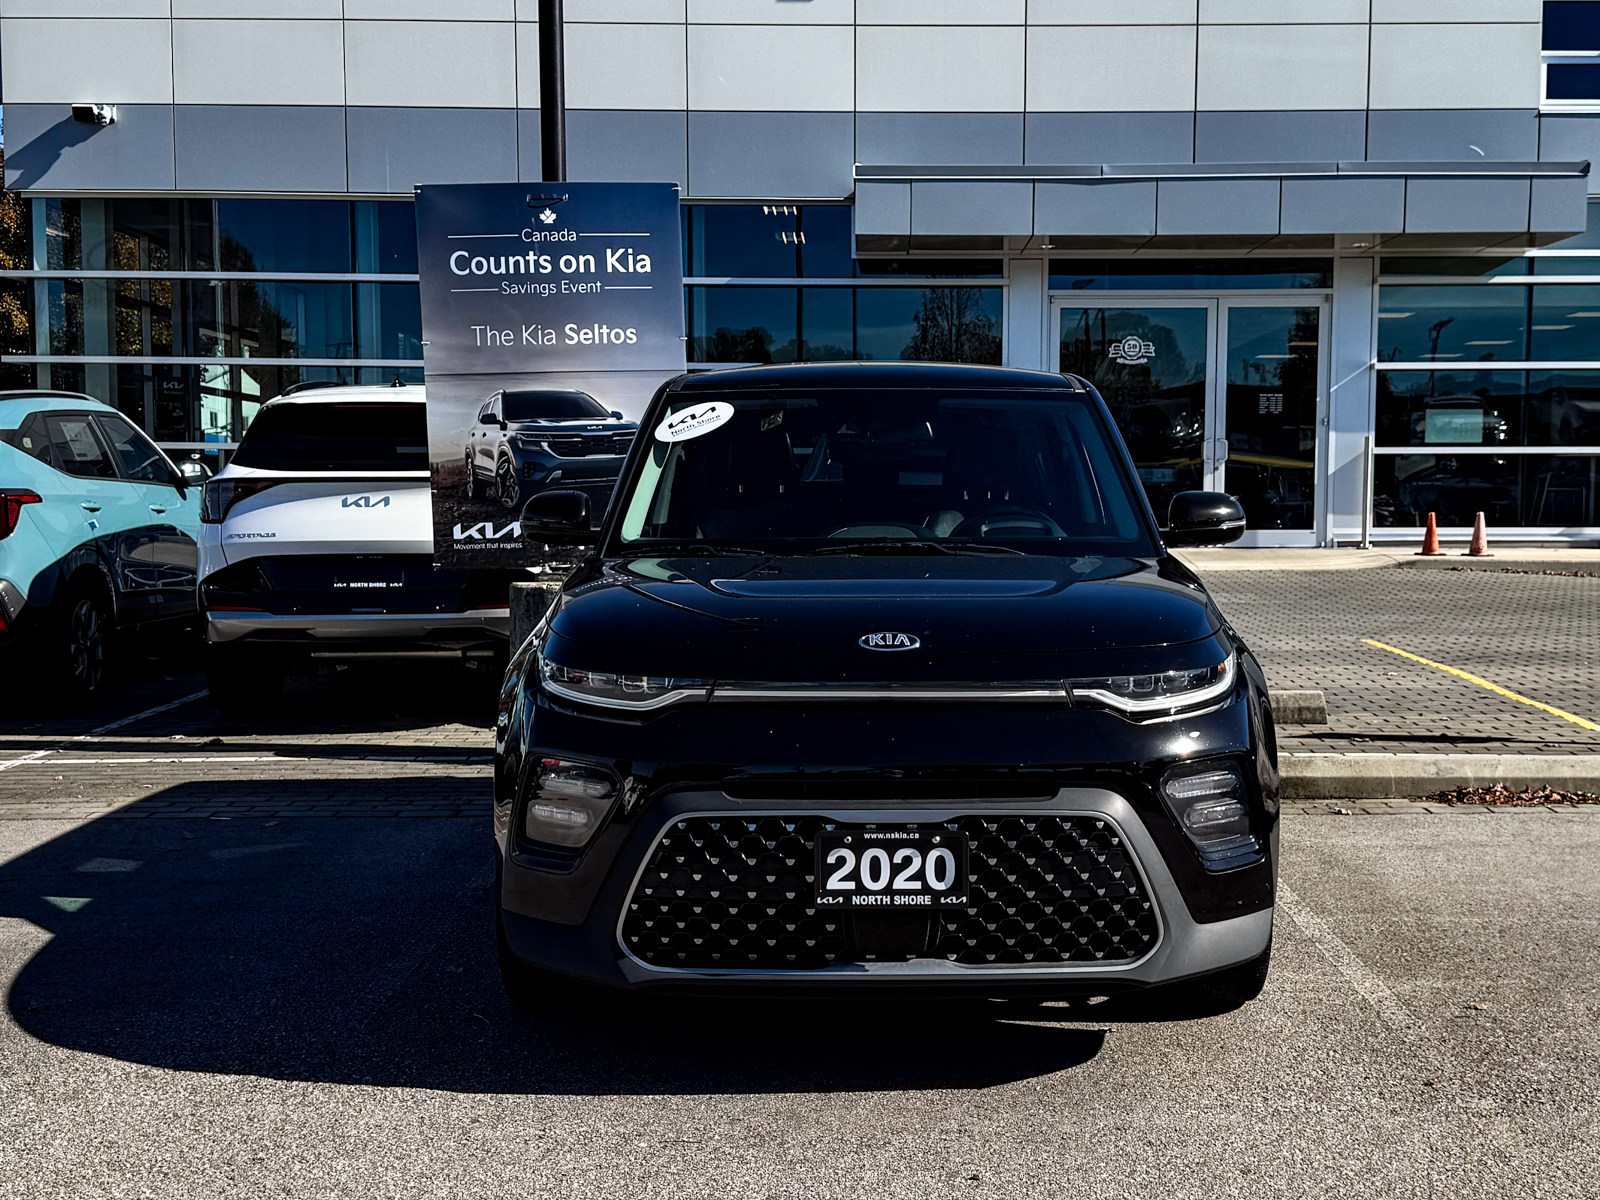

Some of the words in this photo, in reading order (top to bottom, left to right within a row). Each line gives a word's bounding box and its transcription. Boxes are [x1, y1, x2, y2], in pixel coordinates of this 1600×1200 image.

[521, 228, 577, 242] Canada
[449, 250, 552, 276] Counts
[559, 254, 595, 273] on
[605, 248, 652, 273] Kia
[501, 280, 557, 297] Savings
[562, 280, 602, 293] Event
[471, 325, 514, 346] The
[522, 324, 556, 345] Kia
[564, 323, 637, 344] Seltos
[671, 423, 695, 436] North
[342, 496, 390, 508] KIA
[453, 521, 522, 540] KIA
[499, 541, 523, 550] inspires
[868, 633, 911, 646] KIA
[826, 847, 956, 891] 2020
[816, 895, 844, 905] KIA
[851, 895, 891, 905] NORTH
[893, 895, 932, 905] SHORE
[940, 895, 967, 905] KIA
